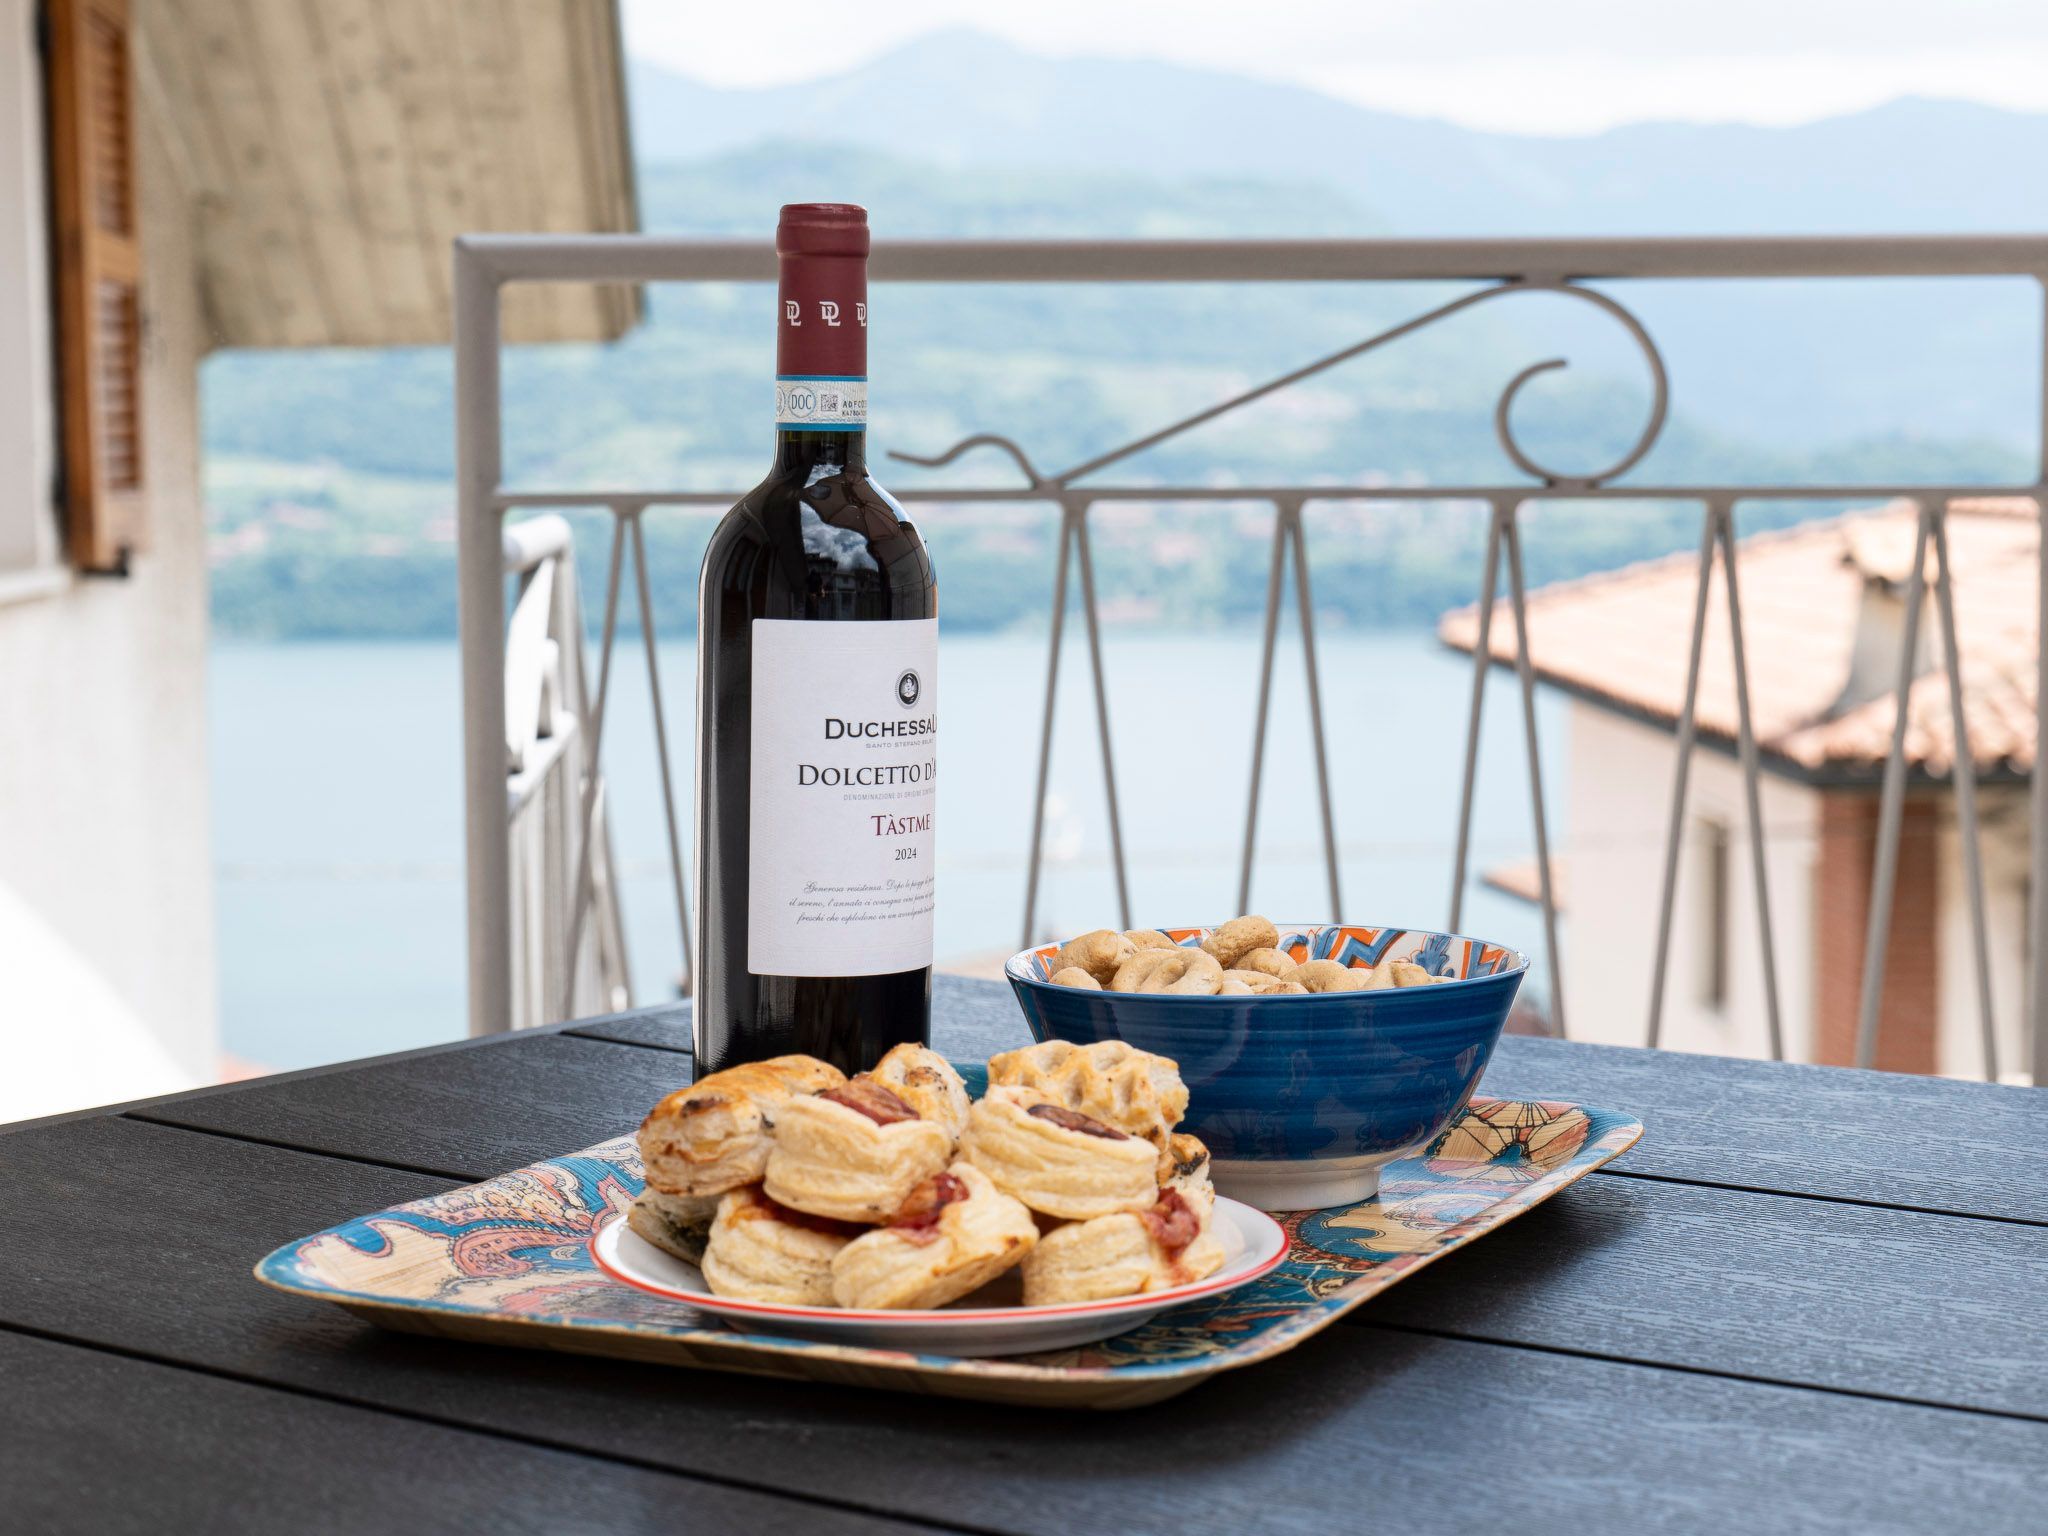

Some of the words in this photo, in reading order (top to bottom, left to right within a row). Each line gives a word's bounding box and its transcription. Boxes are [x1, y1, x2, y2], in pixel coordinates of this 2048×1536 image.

[791, 394, 812, 410] DOC
[894, 740, 921, 748] STEFANO
[797, 764, 921, 786] DOLCETTO
[843, 792, 895, 801] DENOMINAZIONE
[896, 791, 903, 799] DI
[870, 813, 931, 837] TÀSTME
[894, 847, 917, 861] 2024
[803, 880, 844, 894] Generosa
[789, 898, 798, 907] il
[796, 912, 826, 925] freschi
[826, 912, 839, 922] che
[841, 911, 877, 925] esplodono
